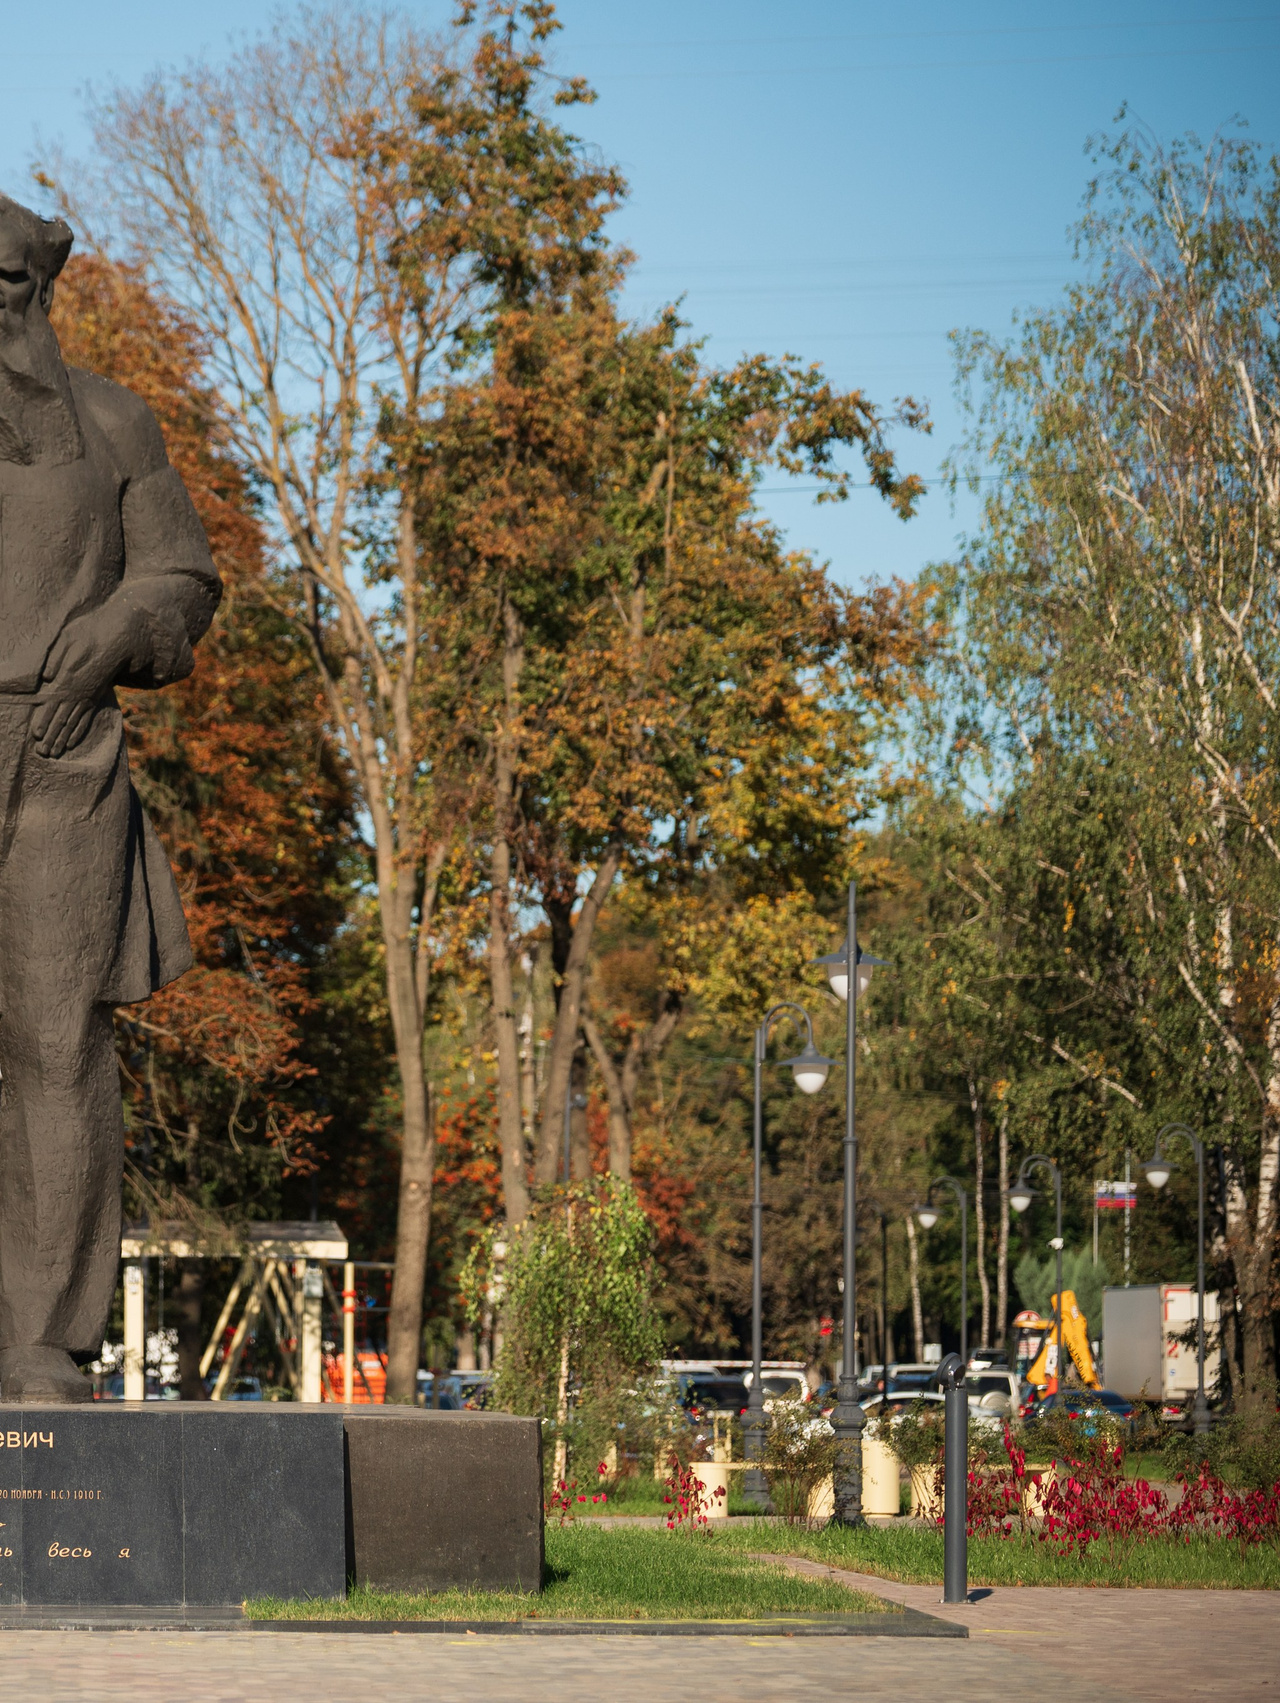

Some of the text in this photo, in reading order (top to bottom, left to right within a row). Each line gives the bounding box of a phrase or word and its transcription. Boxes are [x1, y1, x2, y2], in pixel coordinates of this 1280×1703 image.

[10, 1489, 43, 1499] НОЯБРЯ
[73, 1490, 94, 1500] 1910
[47, 1541, 92, 1559] весь
[118, 1547, 131, 1559] я
